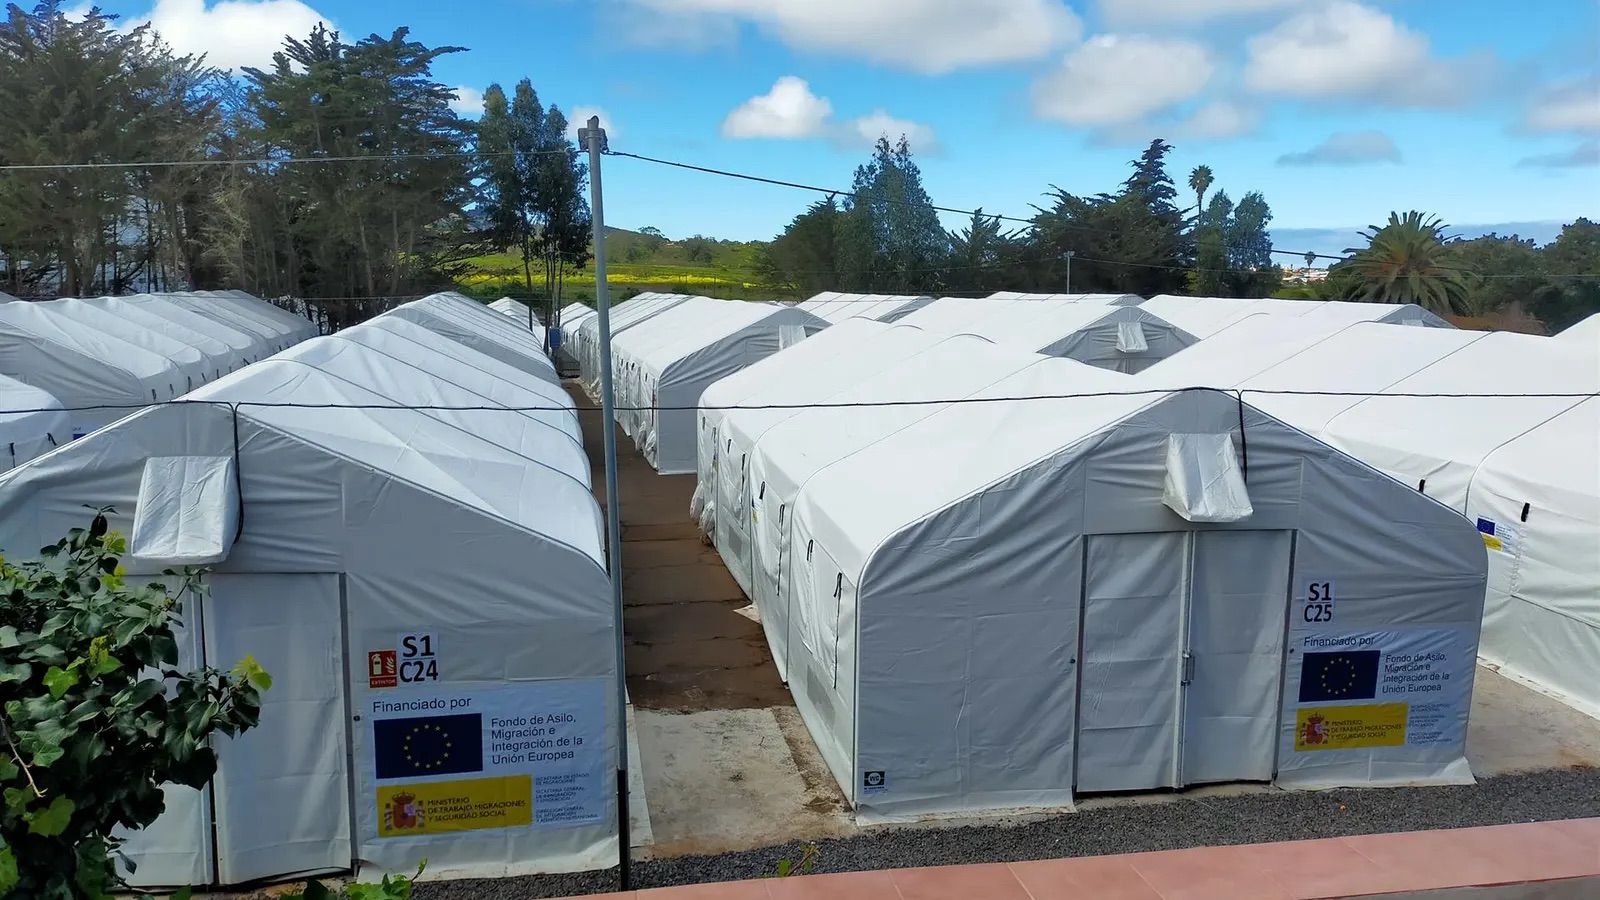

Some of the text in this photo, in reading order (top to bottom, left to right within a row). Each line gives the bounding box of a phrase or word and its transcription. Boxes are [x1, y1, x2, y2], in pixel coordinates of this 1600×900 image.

[1308, 582, 1332, 602] S1
[1303, 604, 1332, 623] C25
[402, 635, 435, 657] S1
[1303, 636, 1375, 647] Financiado por
[1385, 654, 1411, 663] Fondo
[399, 659, 439, 683] C24
[1383, 672, 1450, 684] Integración de la
[1382, 683, 1442, 694] Unión Europea
[373, 698, 472, 713] Financiado por
[491, 713, 577, 728] Fondo de Asilo,
[491, 727, 556, 740] Migración e
[492, 736, 583, 752] Integración de la
[492, 750, 574, 765] Unión Europea
[427, 797, 470, 806] MINISTERIO
[427, 807, 438, 815] DE
[475, 800, 527, 811] MIGRACIONES
[434, 812, 478, 822] SEGURIDAD
[479, 809, 507, 818] SOCIAL
